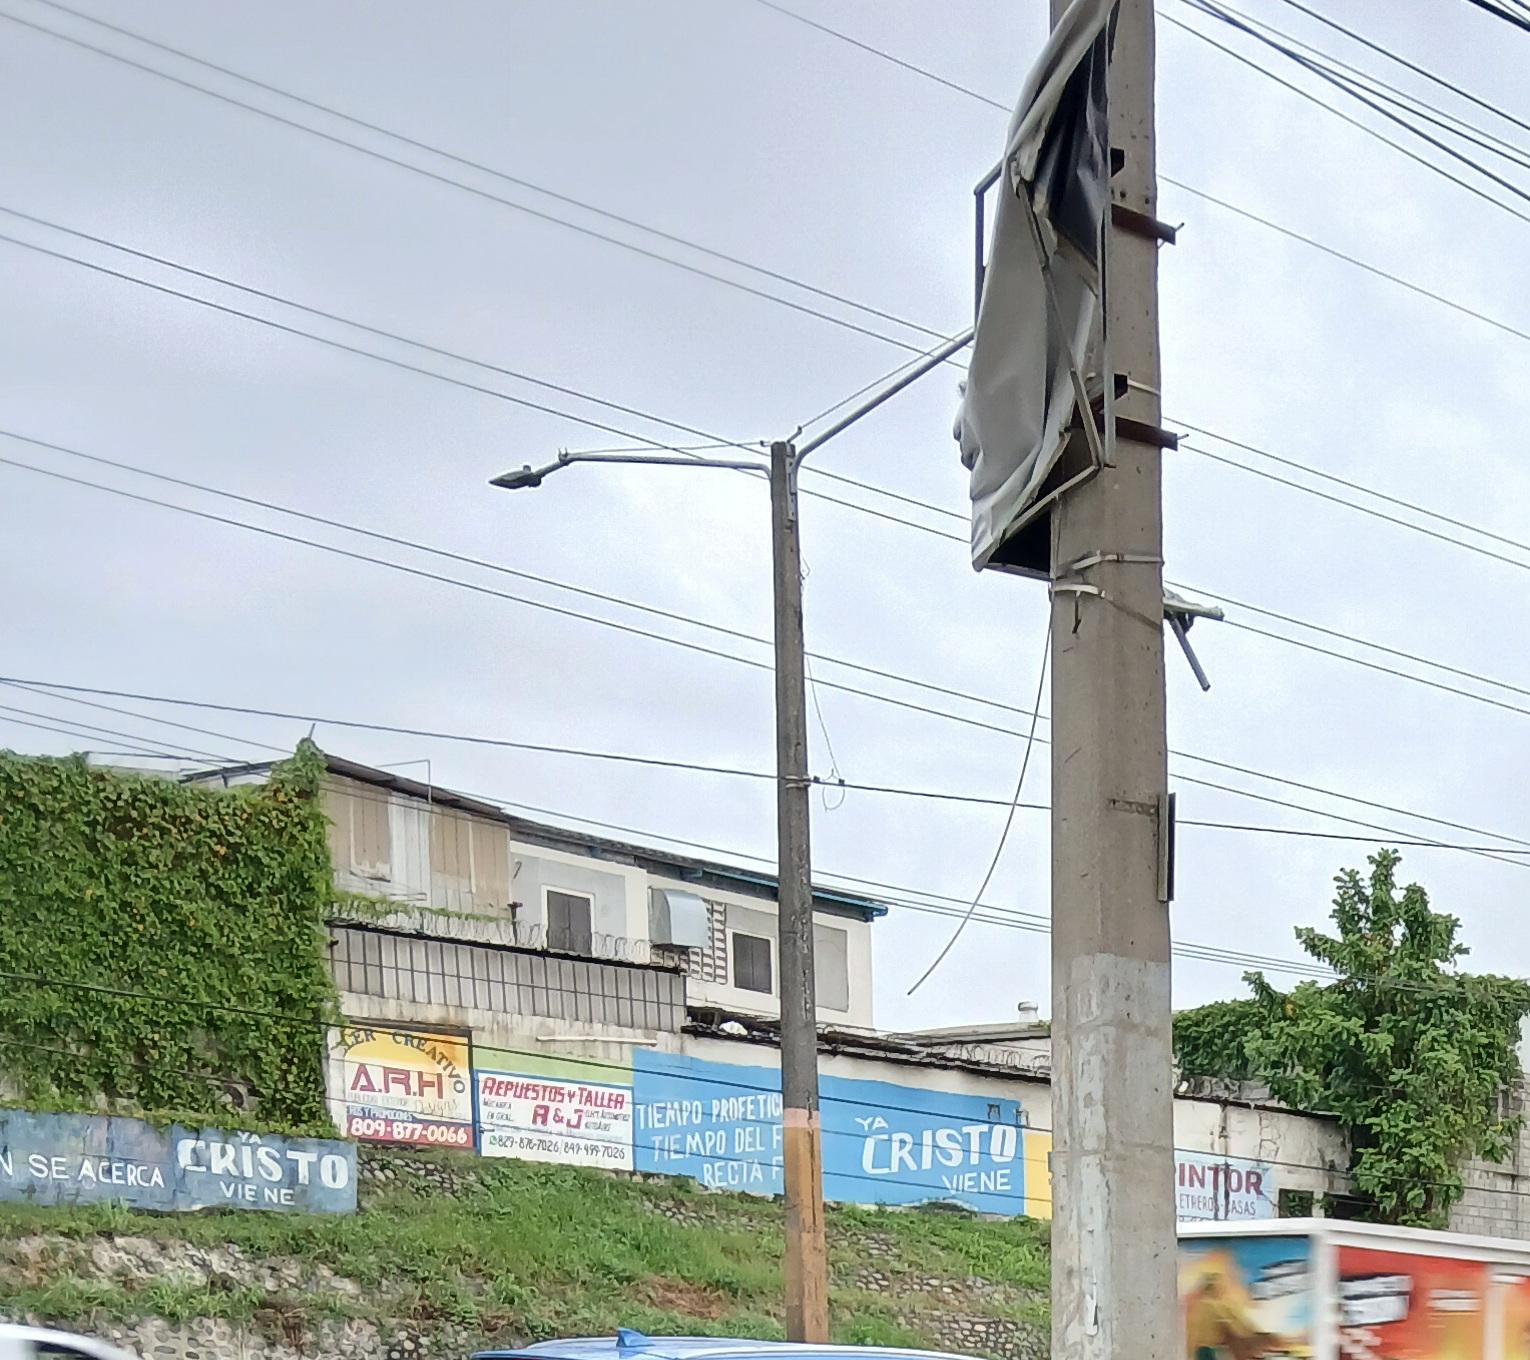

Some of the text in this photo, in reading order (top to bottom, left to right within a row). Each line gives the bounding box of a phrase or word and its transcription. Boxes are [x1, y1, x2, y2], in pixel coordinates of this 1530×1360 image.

[392, 1031, 466, 1094] CREATIVO
[481, 1077, 565, 1103] REPUESTOS
[577, 1086, 625, 1110] TALLER
[350, 1117, 468, 1144] 809-877-0066
[552, 1108, 565, 1124] &
[566, 1109, 584, 1130] J
[636, 1101, 702, 1130] TIEMPO
[855, 1115, 889, 1132] YA
[236, 1130, 262, 1144] YA
[651, 1129, 727, 1162] TIEMPO
[735, 1126, 765, 1154] DEL
[862, 1124, 1017, 1175] CRISTO
[28, 1154, 70, 1180] SE
[76, 1159, 165, 1189] ACERCA
[176, 1138, 350, 1189] CRISTO
[703, 1159, 764, 1187] RECTA
[1178, 1162, 1264, 1196] INTOR
[942, 1169, 1012, 1195] VIENE
